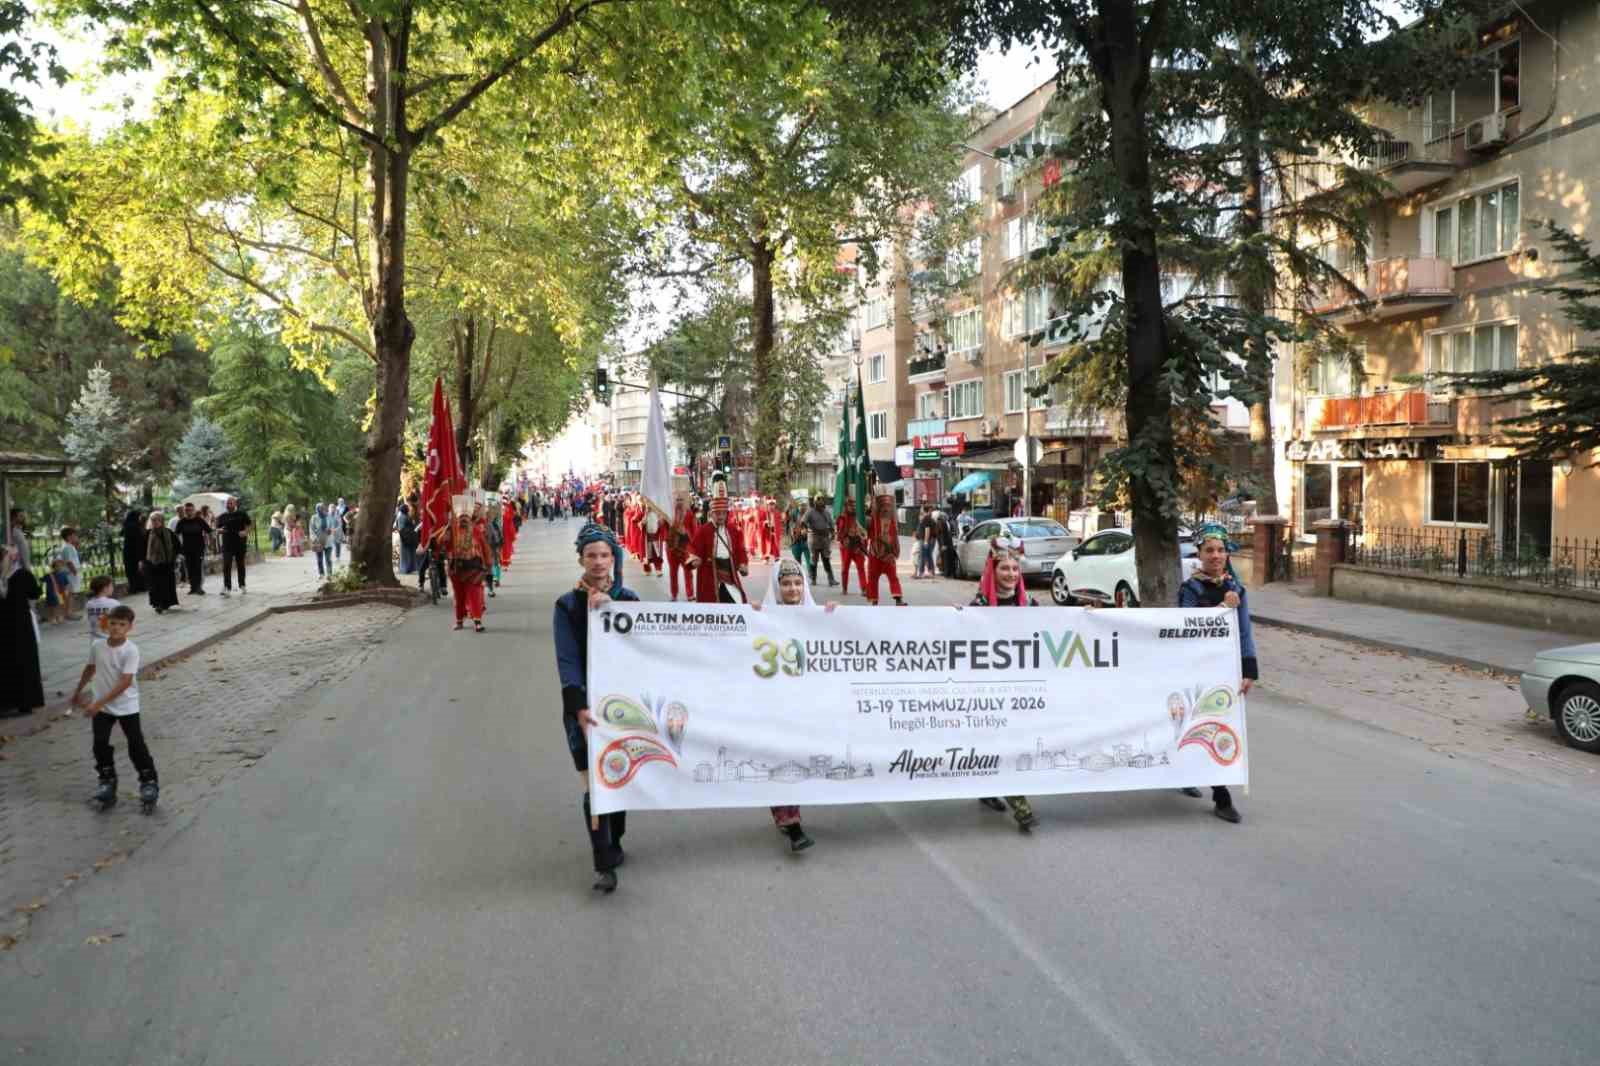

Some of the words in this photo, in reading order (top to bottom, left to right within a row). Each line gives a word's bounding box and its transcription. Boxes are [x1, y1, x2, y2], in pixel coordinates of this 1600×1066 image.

[601, 611, 633, 634] 10
[635, 612, 678, 624] ALTIN
[806, 640, 946, 655] ULUSLARARASI
[753, 637, 805, 678] 39
[806, 658, 877, 672] KÜLTÜR
[886, 657, 946, 672] SANAT
[857, 700, 894, 713] 13-19
[898, 698, 1005, 713] TEMMUZ/JULY
[1011, 697, 1046, 710] 2026
[888, 749, 943, 780] Alper
[945, 748, 1000, 771] Taban
